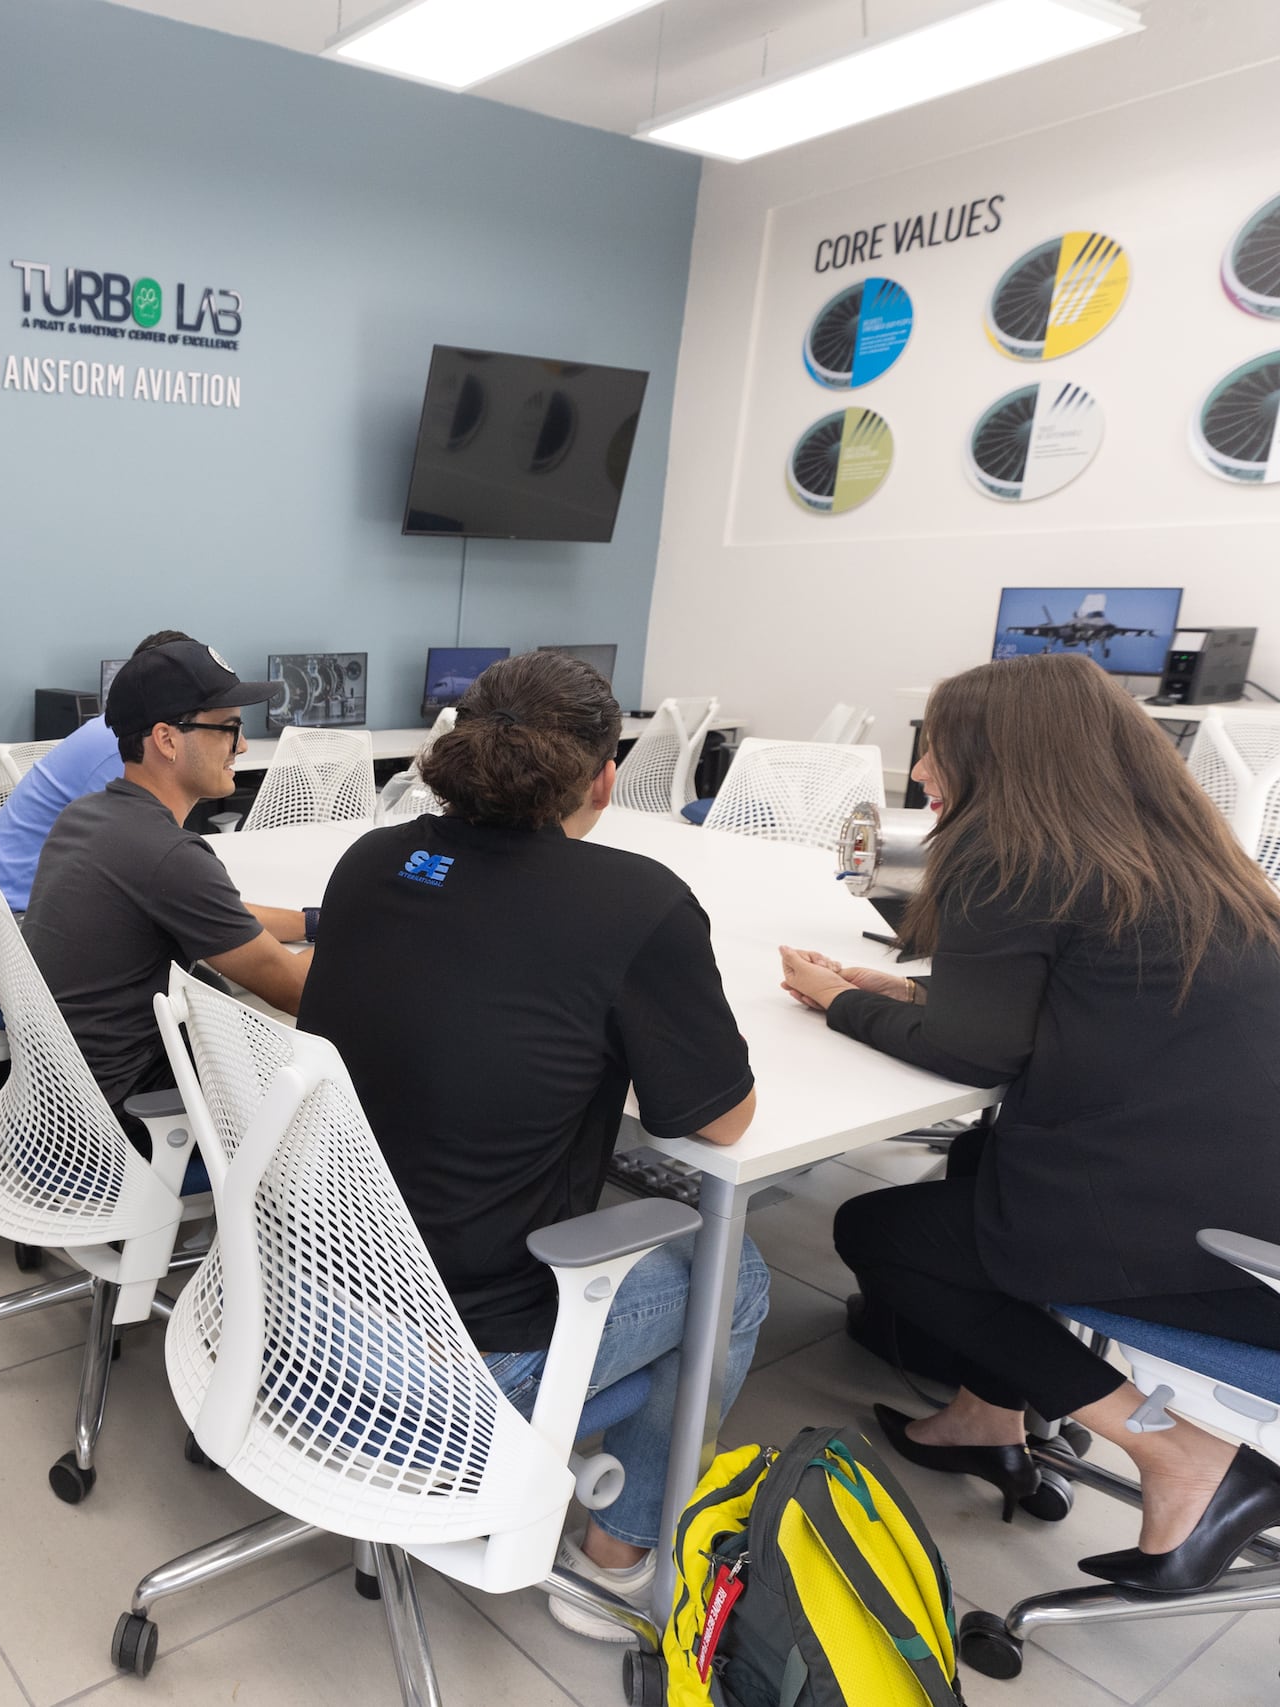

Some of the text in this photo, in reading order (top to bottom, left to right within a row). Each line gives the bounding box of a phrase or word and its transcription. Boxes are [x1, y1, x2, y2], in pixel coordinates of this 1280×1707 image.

[815, 194, 1005, 273] CORE VALUES
[12, 260, 242, 336] TURBO LAB
[22, 318, 239, 350] A PRATT & WHITNEY CENTER OF EXCELLENCE
[133, 367, 240, 408] AVIATION
[405, 850, 455, 881] SAE
[710, 1586, 727, 1620] REMOVE
[703, 1614, 716, 1643] BEFORE
